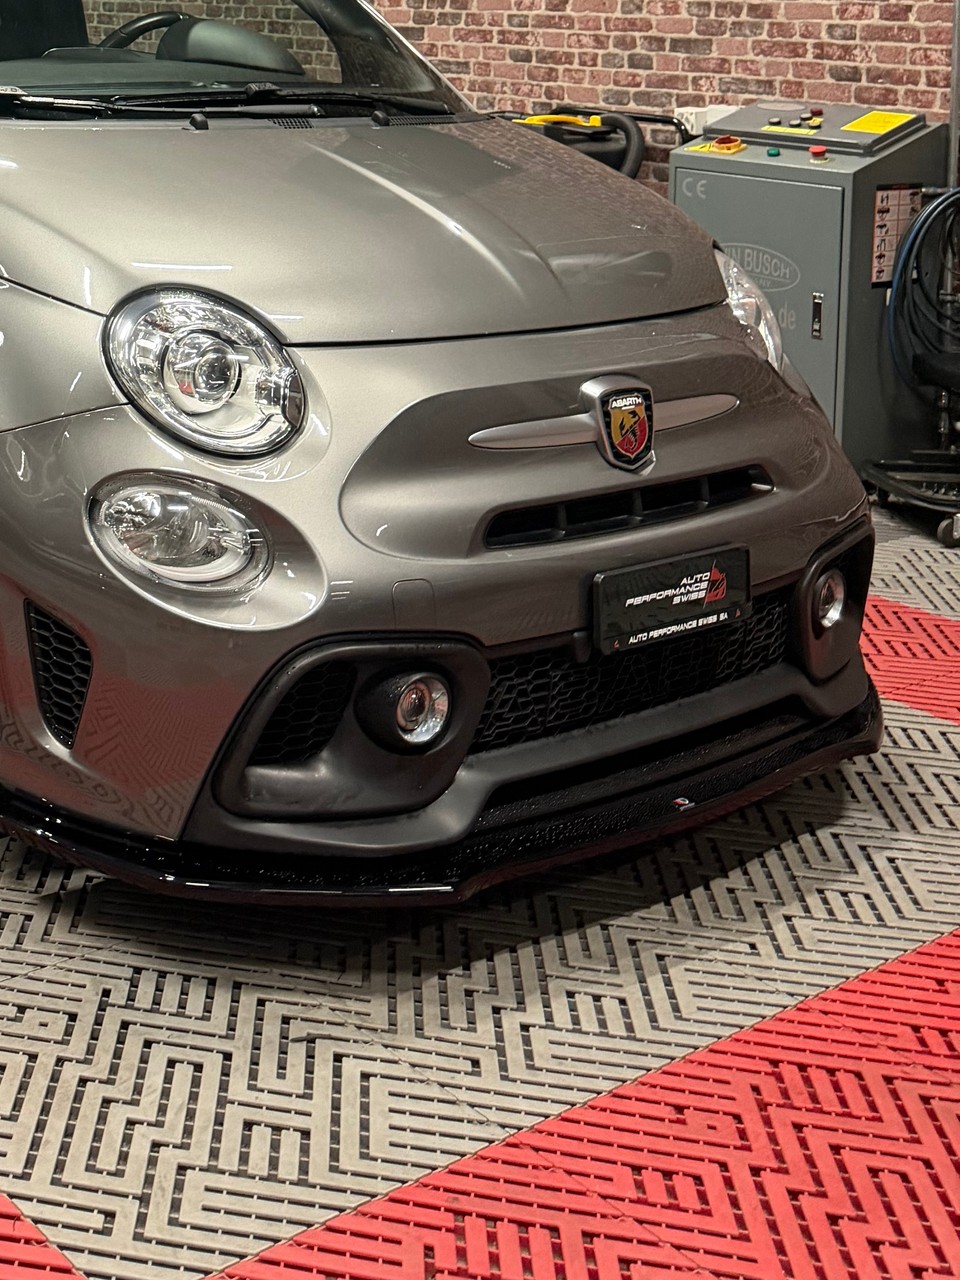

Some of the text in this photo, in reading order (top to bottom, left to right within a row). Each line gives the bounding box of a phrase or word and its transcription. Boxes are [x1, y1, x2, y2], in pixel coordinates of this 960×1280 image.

[744, 248, 790, 279] BUSCH
[611, 397, 642, 408] ABARTH
[680, 571, 711, 585] AUTO
[625, 581, 709, 608] PERFORMANCE
[672, 589, 707, 605] SWISS
[628, 632, 648, 645] AUTO
[648, 619, 697, 639] PERFORMANCE
[719, 612, 729, 621] SA
